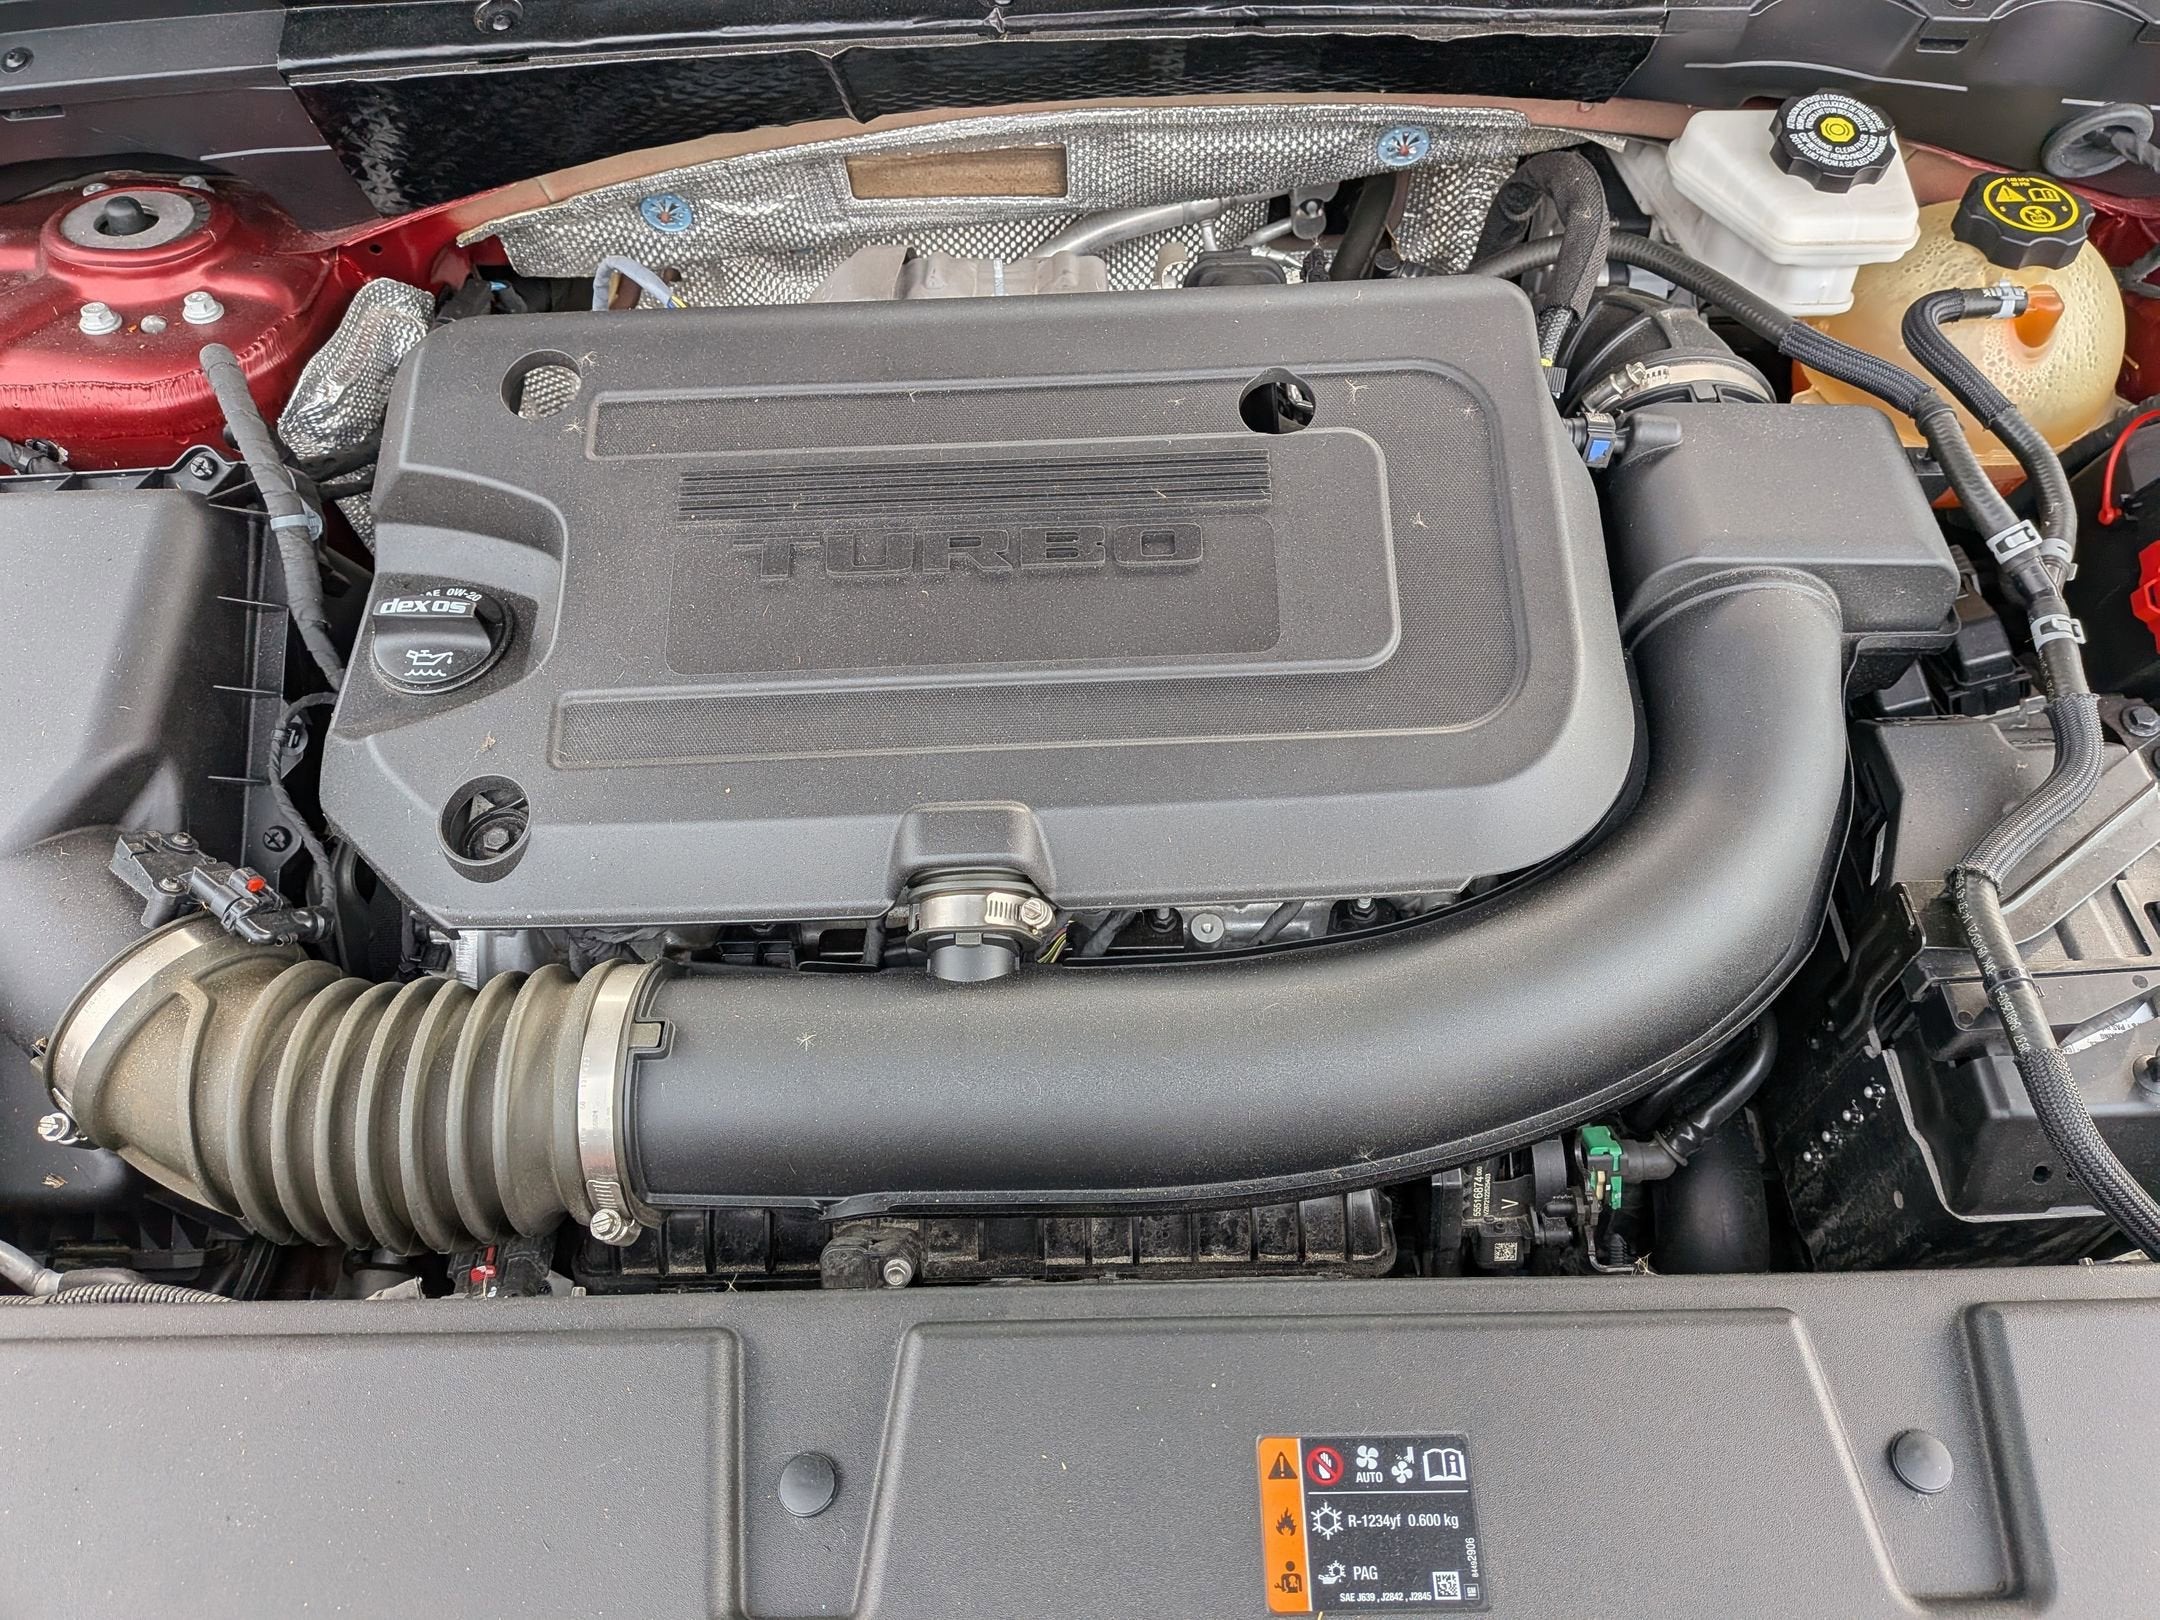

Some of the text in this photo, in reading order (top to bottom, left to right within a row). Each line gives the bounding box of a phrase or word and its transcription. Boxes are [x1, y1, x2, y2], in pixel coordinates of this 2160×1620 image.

[1798, 132, 1810, 143] CAP
[1806, 142, 1830, 158] BEFORE
[1808, 130, 1869, 154] WARNING CLEAN FILLER
[1800, 146, 1820, 160] FLUID
[1818, 156, 1839, 167] FROM
[1844, 157, 1870, 168] SEALED
[733, 523, 1203, 582] TURBO
[446, 587, 482, 602] 0W-20
[380, 598, 471, 614] dexos
[1356, 1471, 1383, 1483] AUTO
[1348, 1513, 1459, 1529] R-1234yf 0.600 kg
[1353, 1566, 1378, 1580] PAG
[1340, 1593, 1355, 1602] SAE
[1409, 1591, 1432, 1601] J2845
